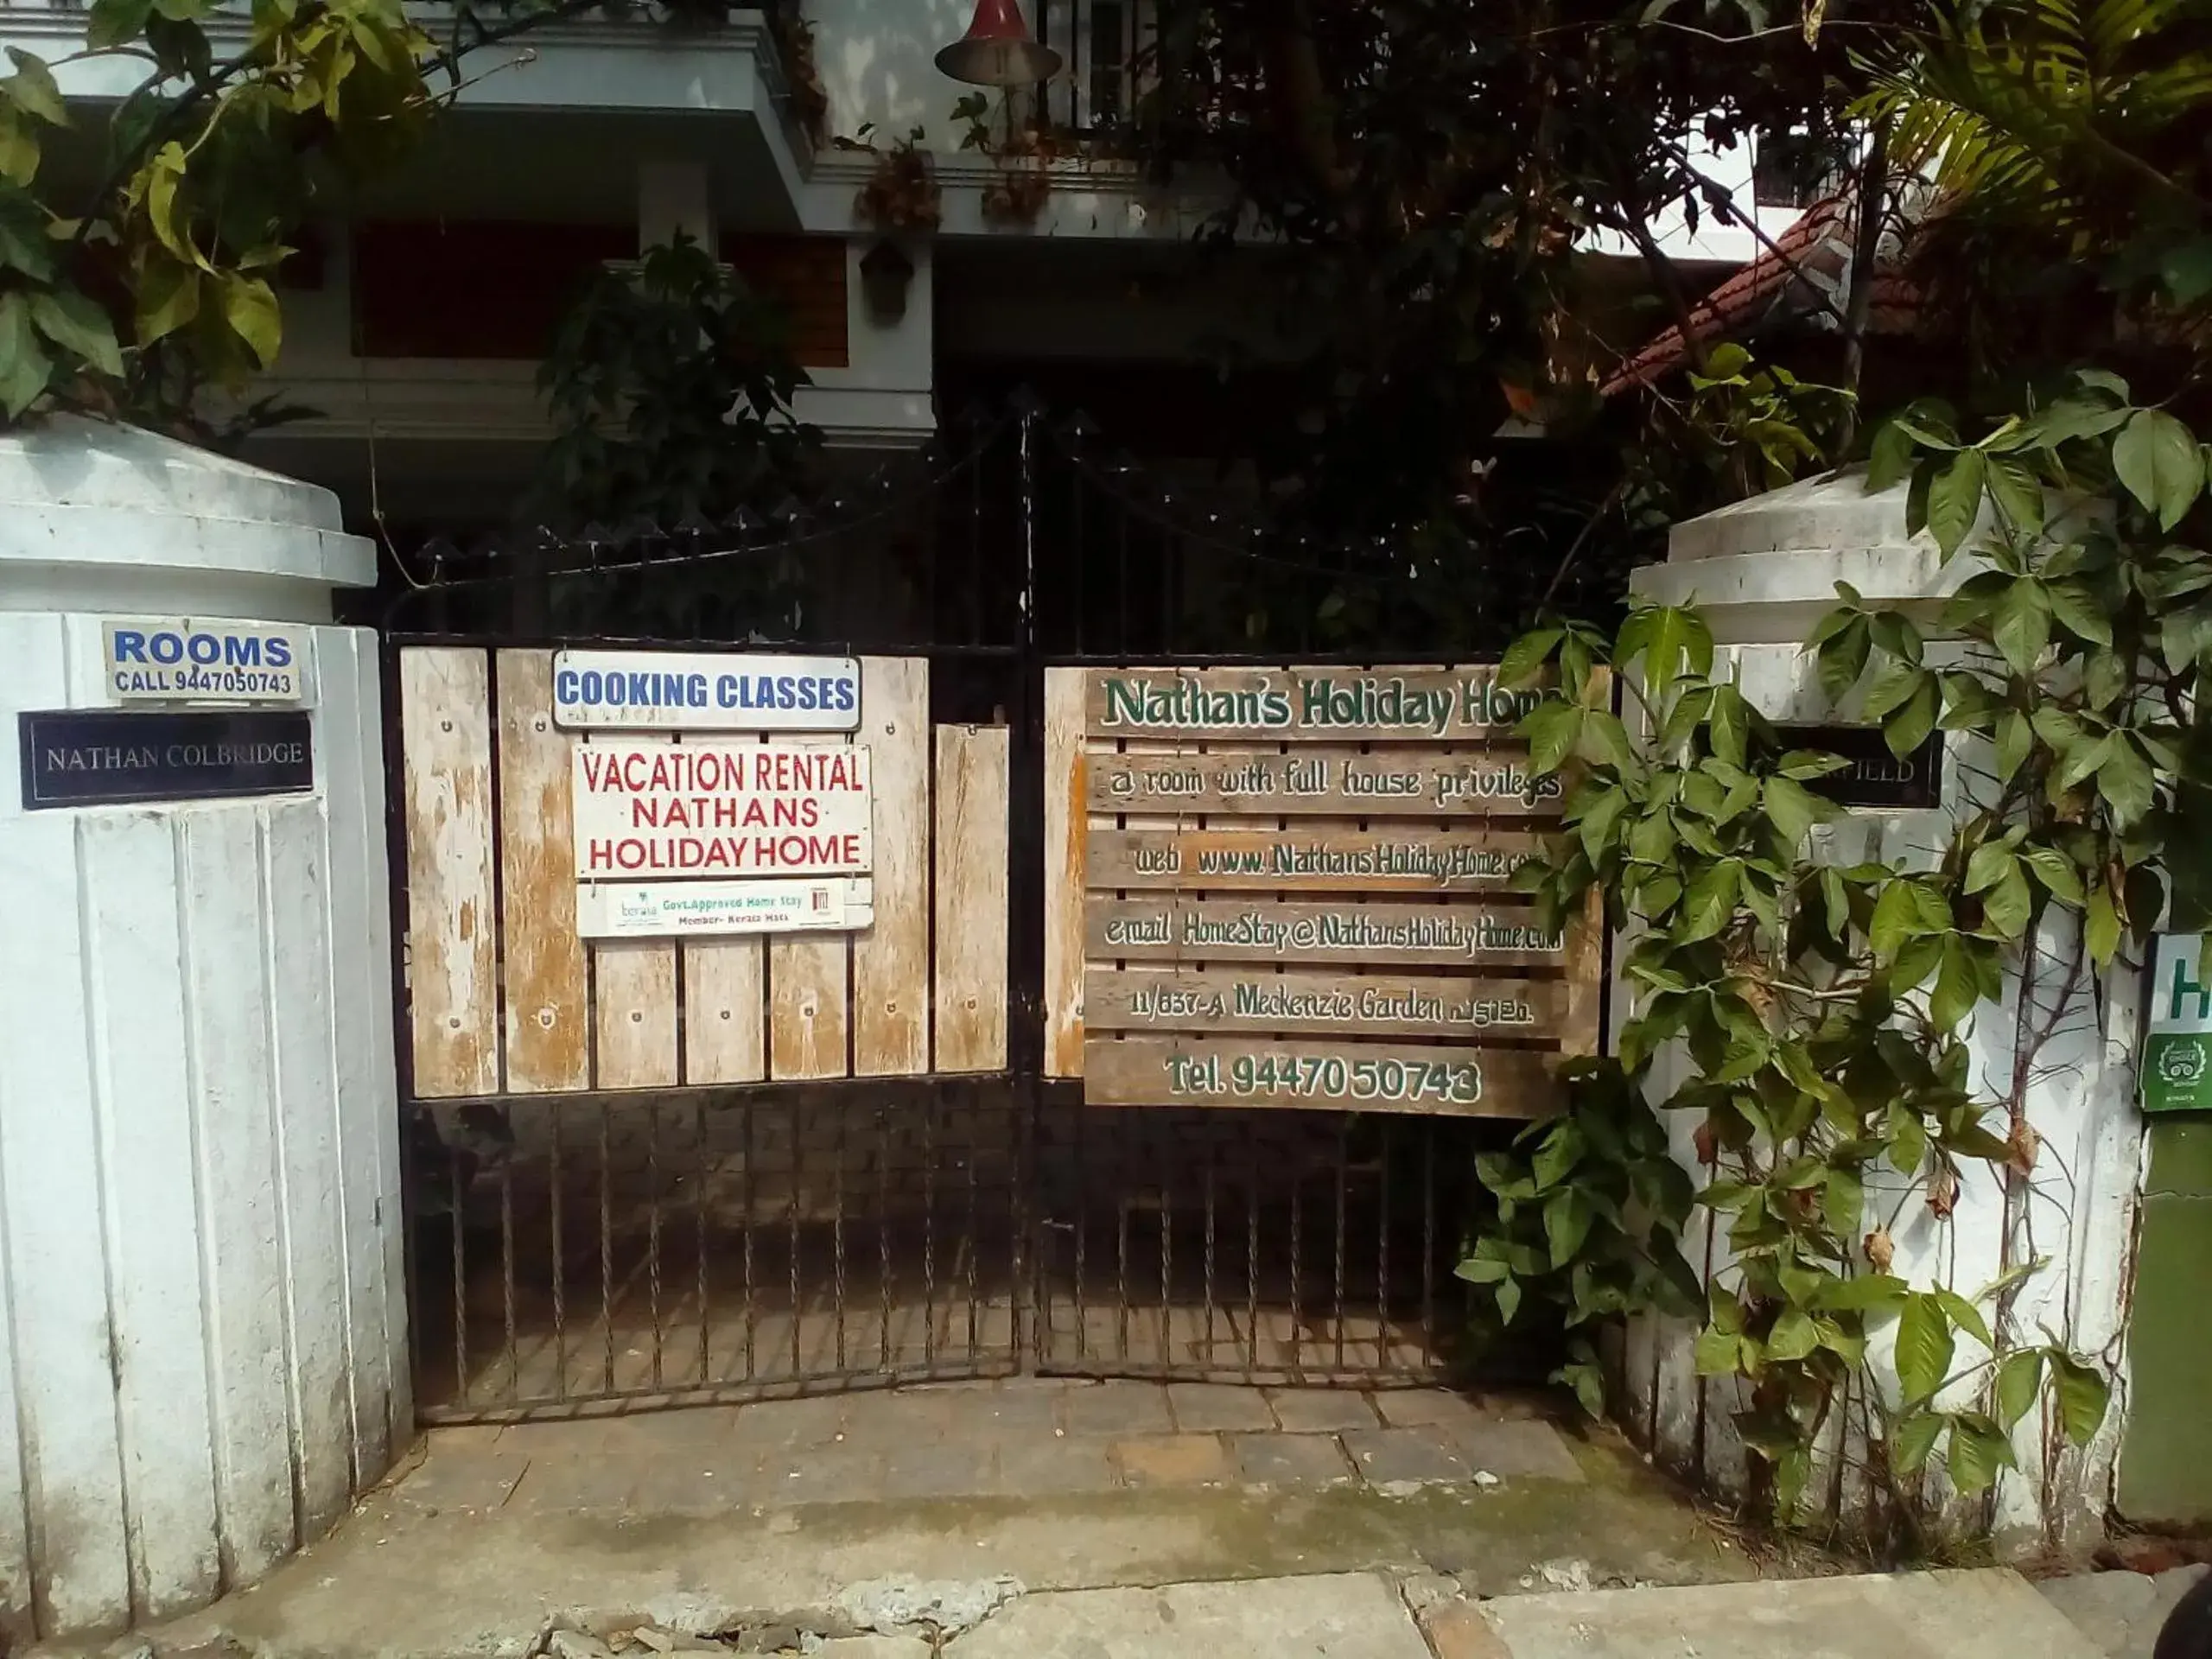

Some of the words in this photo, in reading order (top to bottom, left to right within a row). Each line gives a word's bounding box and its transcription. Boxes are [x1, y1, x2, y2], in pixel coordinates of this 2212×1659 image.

[114, 630, 292, 667] ROOMS
[114, 671, 171, 692] CALL
[175, 671, 292, 694] 9447050743
[556, 671, 708, 708] COOKING
[716, 674, 855, 710] CLASSES
[1100, 677, 1293, 728] Nathan's
[1298, 677, 1456, 738] Holiday
[47, 747, 160, 772] NATHAN
[165, 743, 304, 768] COLBRIDGE
[582, 753, 743, 792] VACATION
[755, 753, 863, 792] RENTAL
[1110, 771, 1136, 796] a
[1144, 770, 1206, 795] room
[1217, 760, 1276, 796] with
[1281, 758, 1329, 796] full
[1340, 760, 1423, 797] house
[632, 797, 819, 829] NATHANS
[589, 836, 749, 870] HOLIDAY
[755, 834, 861, 867] HOME
[1134, 843, 1182, 874] web
[1198, 842, 1532, 888] www.NathansHolidayHome.co
[1105, 912, 1172, 944] email
[1357, 987, 1444, 1023] Garden
[1163, 1053, 1227, 1095] Tel.
